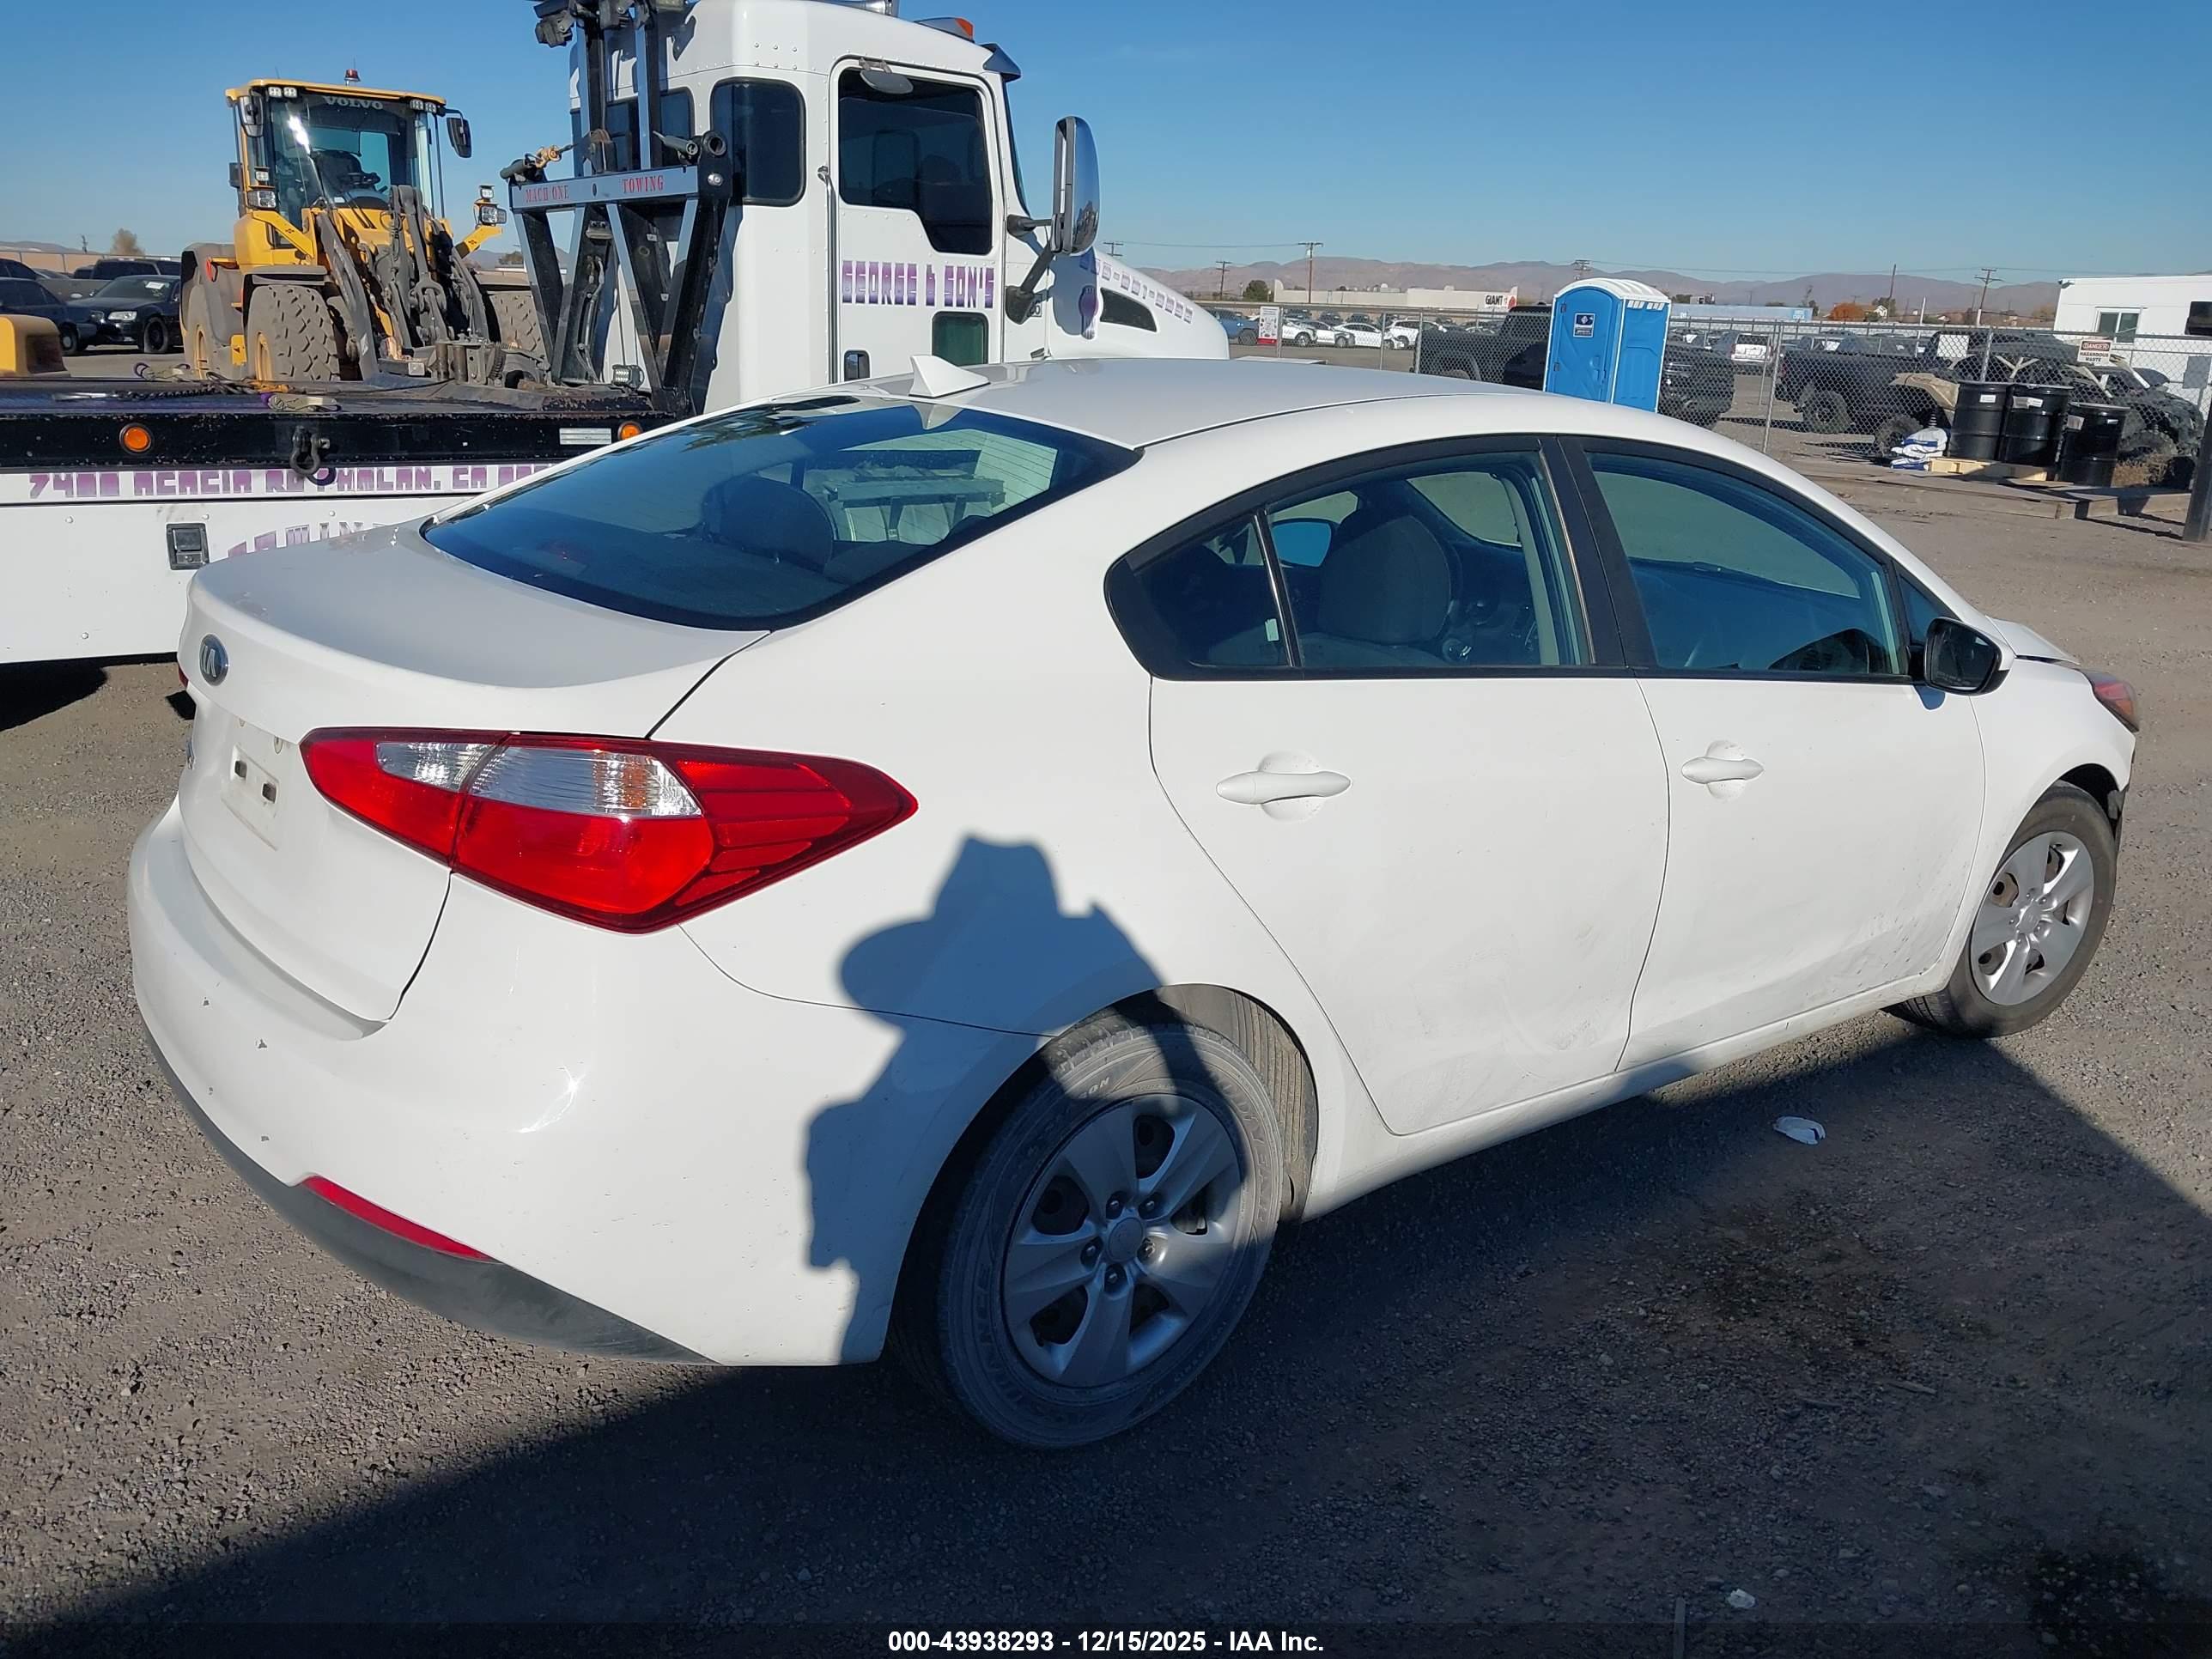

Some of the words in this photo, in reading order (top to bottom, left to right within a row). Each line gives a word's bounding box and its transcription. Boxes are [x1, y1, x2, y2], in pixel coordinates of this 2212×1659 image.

[323, 95, 383, 110] VOLVO
[526, 187, 549, 203] MACH
[551, 185, 569, 201] ONE
[623, 174, 664, 194] TOWING
[842, 260, 917, 306] GEORGE
[945, 265, 994, 308] SON'S
[1486, 295, 1504, 306] GIANT
[134, 471, 252, 496] ACACIA
[453, 465, 487, 489] CA
